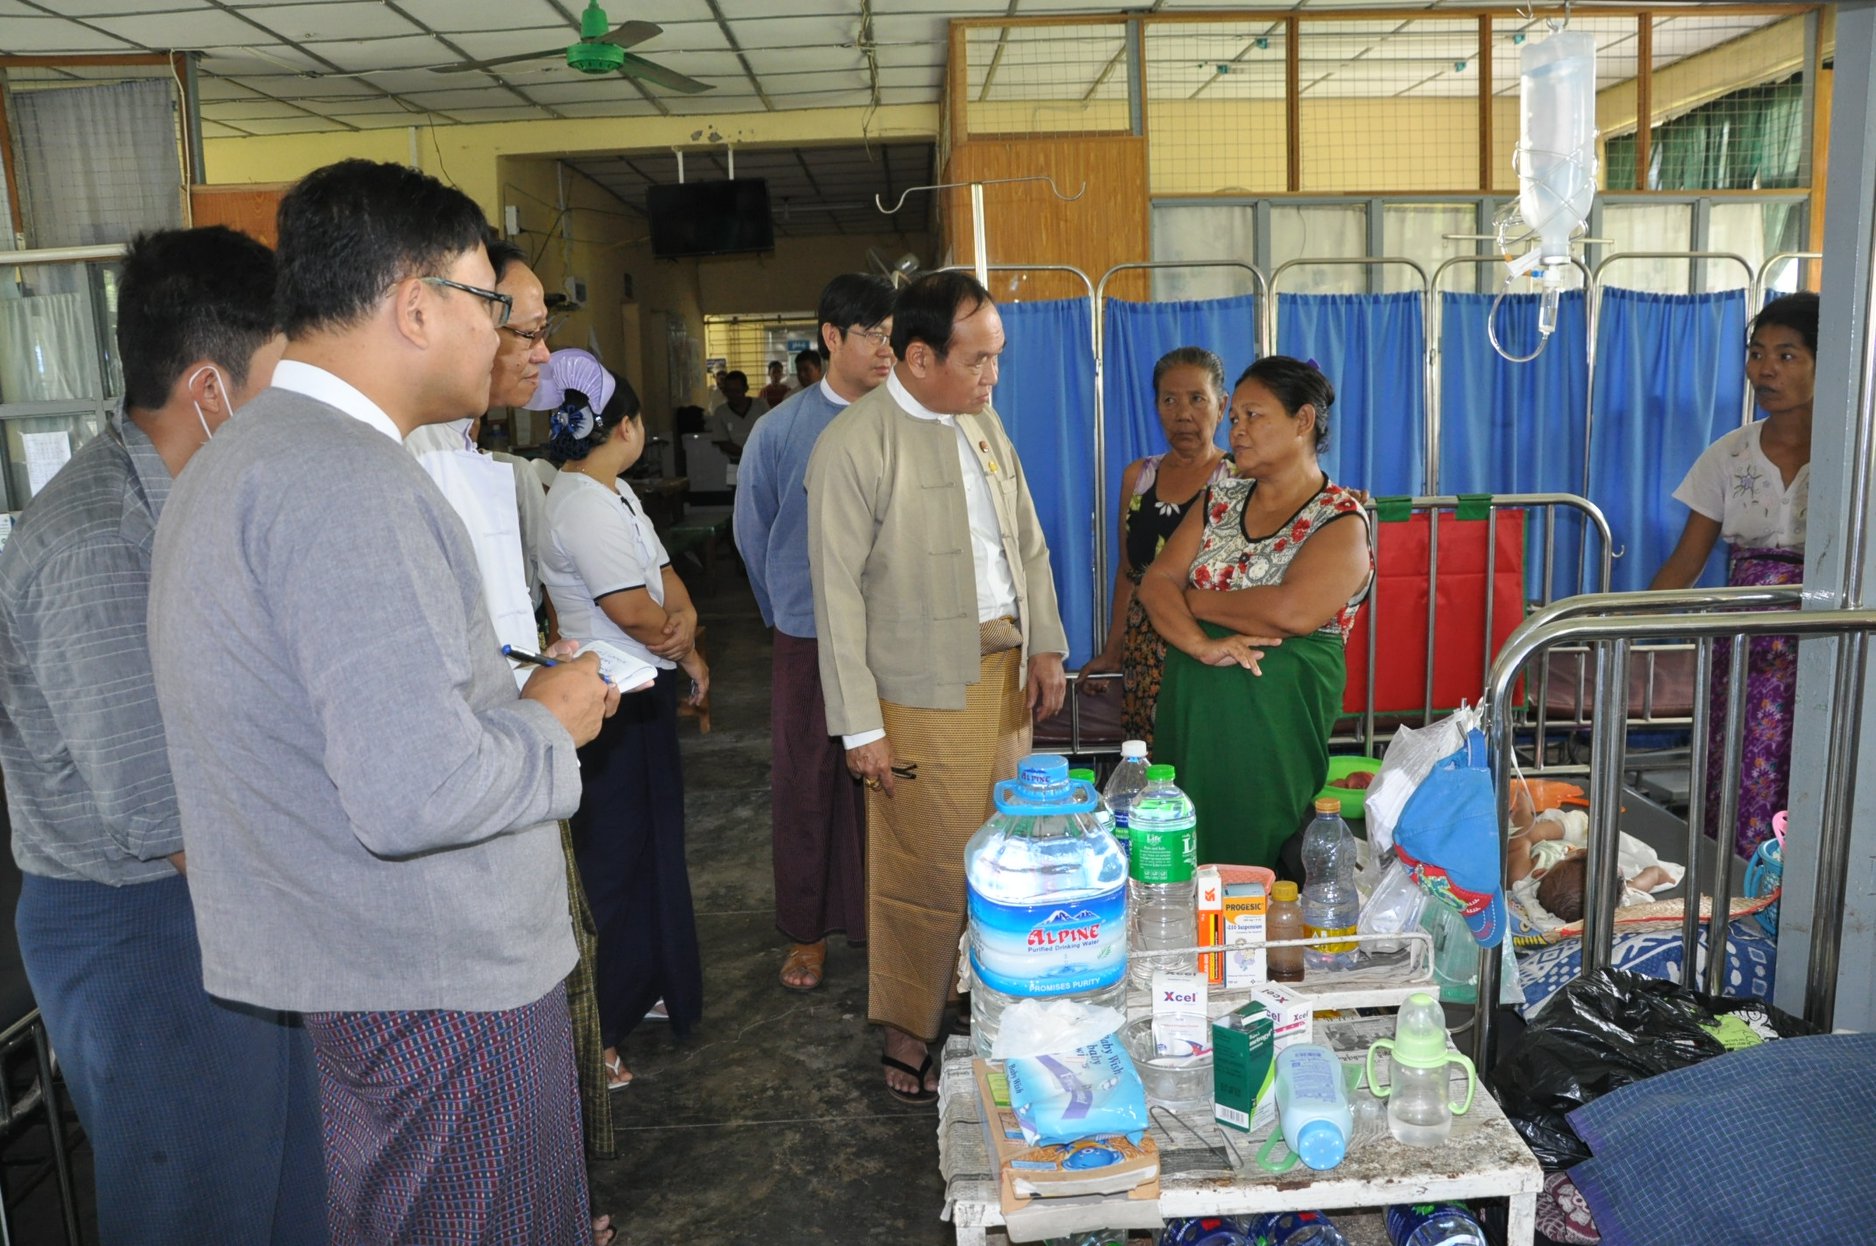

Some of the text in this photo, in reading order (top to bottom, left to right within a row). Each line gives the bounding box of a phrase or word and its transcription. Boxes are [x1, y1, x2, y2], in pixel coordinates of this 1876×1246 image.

[1225, 903, 1262, 911] PROGESIC
[1027, 924, 1100, 946] ALPINE
[1055, 943, 1081, 951] Drinking
[1029, 977, 1101, 992] PROMISES PURITY
[1164, 991, 1196, 1003] Xcel
[1266, 1009, 1280, 1022] cel
[1293, 1010, 1309, 1021] Xcel
[1108, 1055, 1124, 1075] Wish
[1008, 1063, 1024, 1094] Baby Wish
